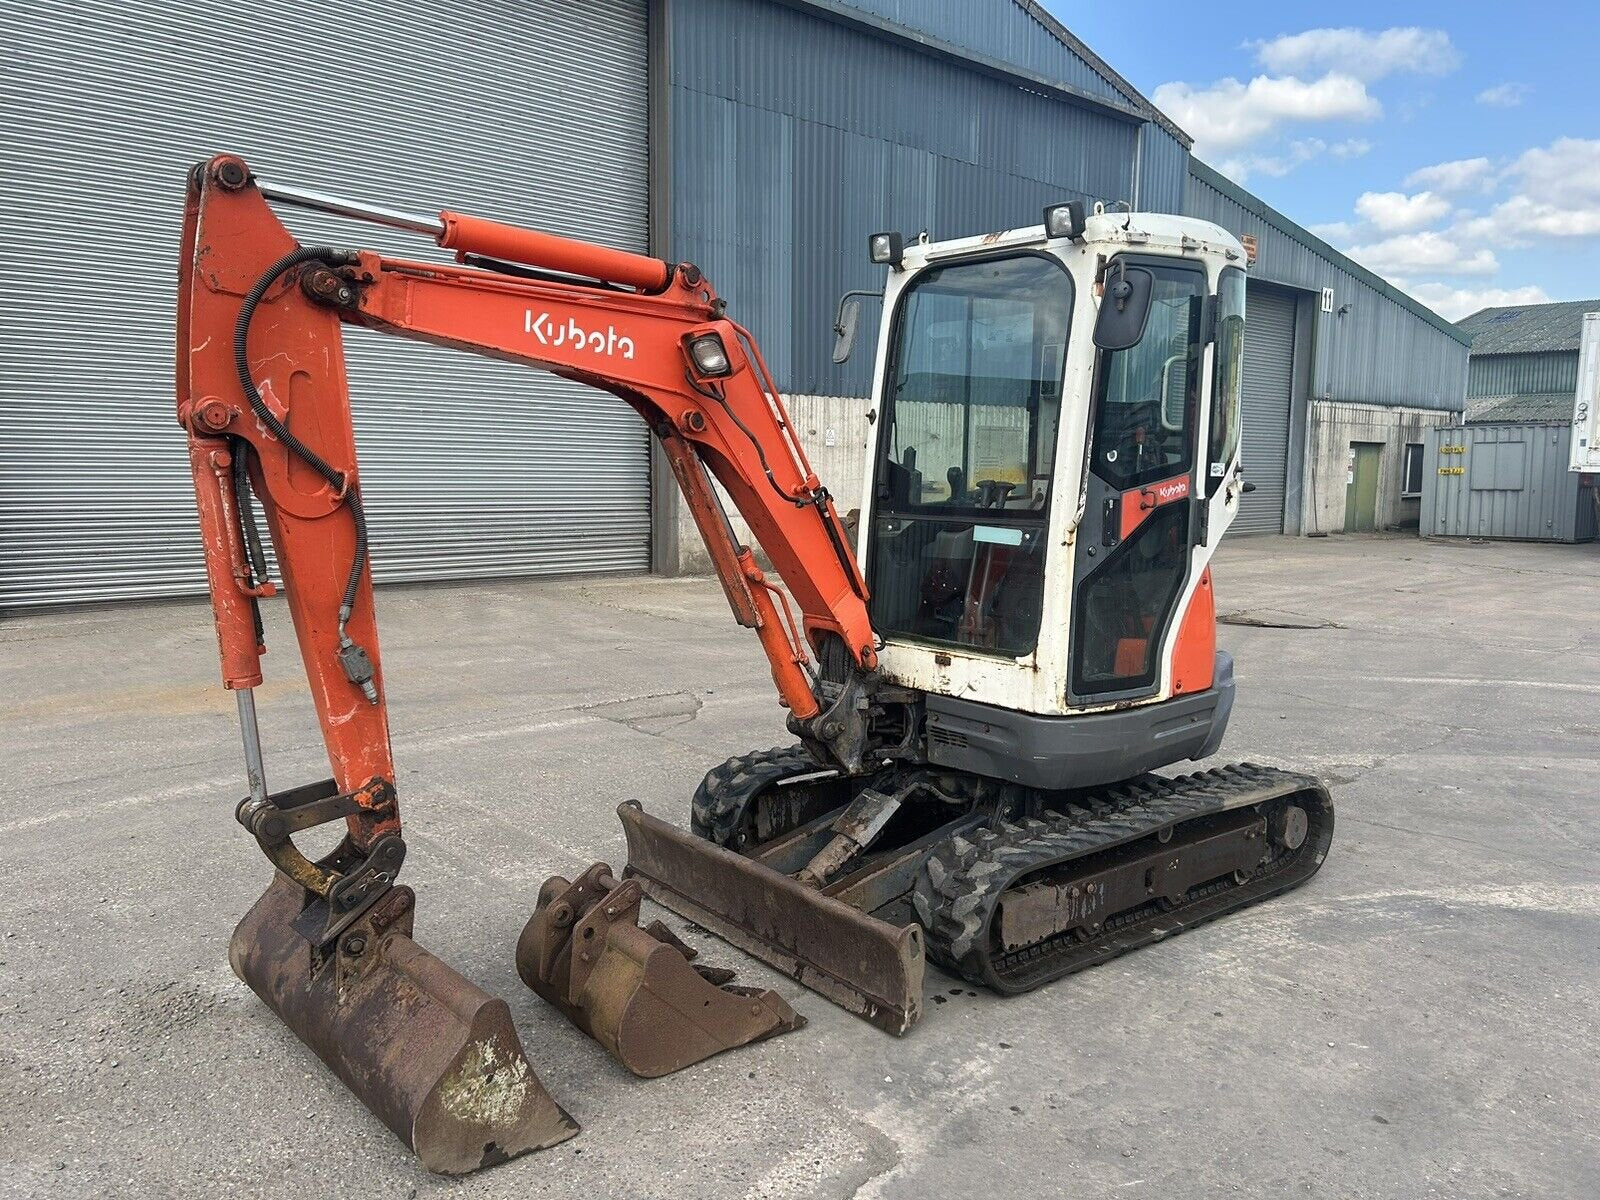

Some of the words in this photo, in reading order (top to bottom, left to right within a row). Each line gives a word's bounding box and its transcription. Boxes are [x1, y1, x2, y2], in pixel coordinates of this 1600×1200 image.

[1323, 290, 1332, 310] 11
[524, 309, 635, 360] Kubota
[1159, 482, 1186, 497] Kubota
